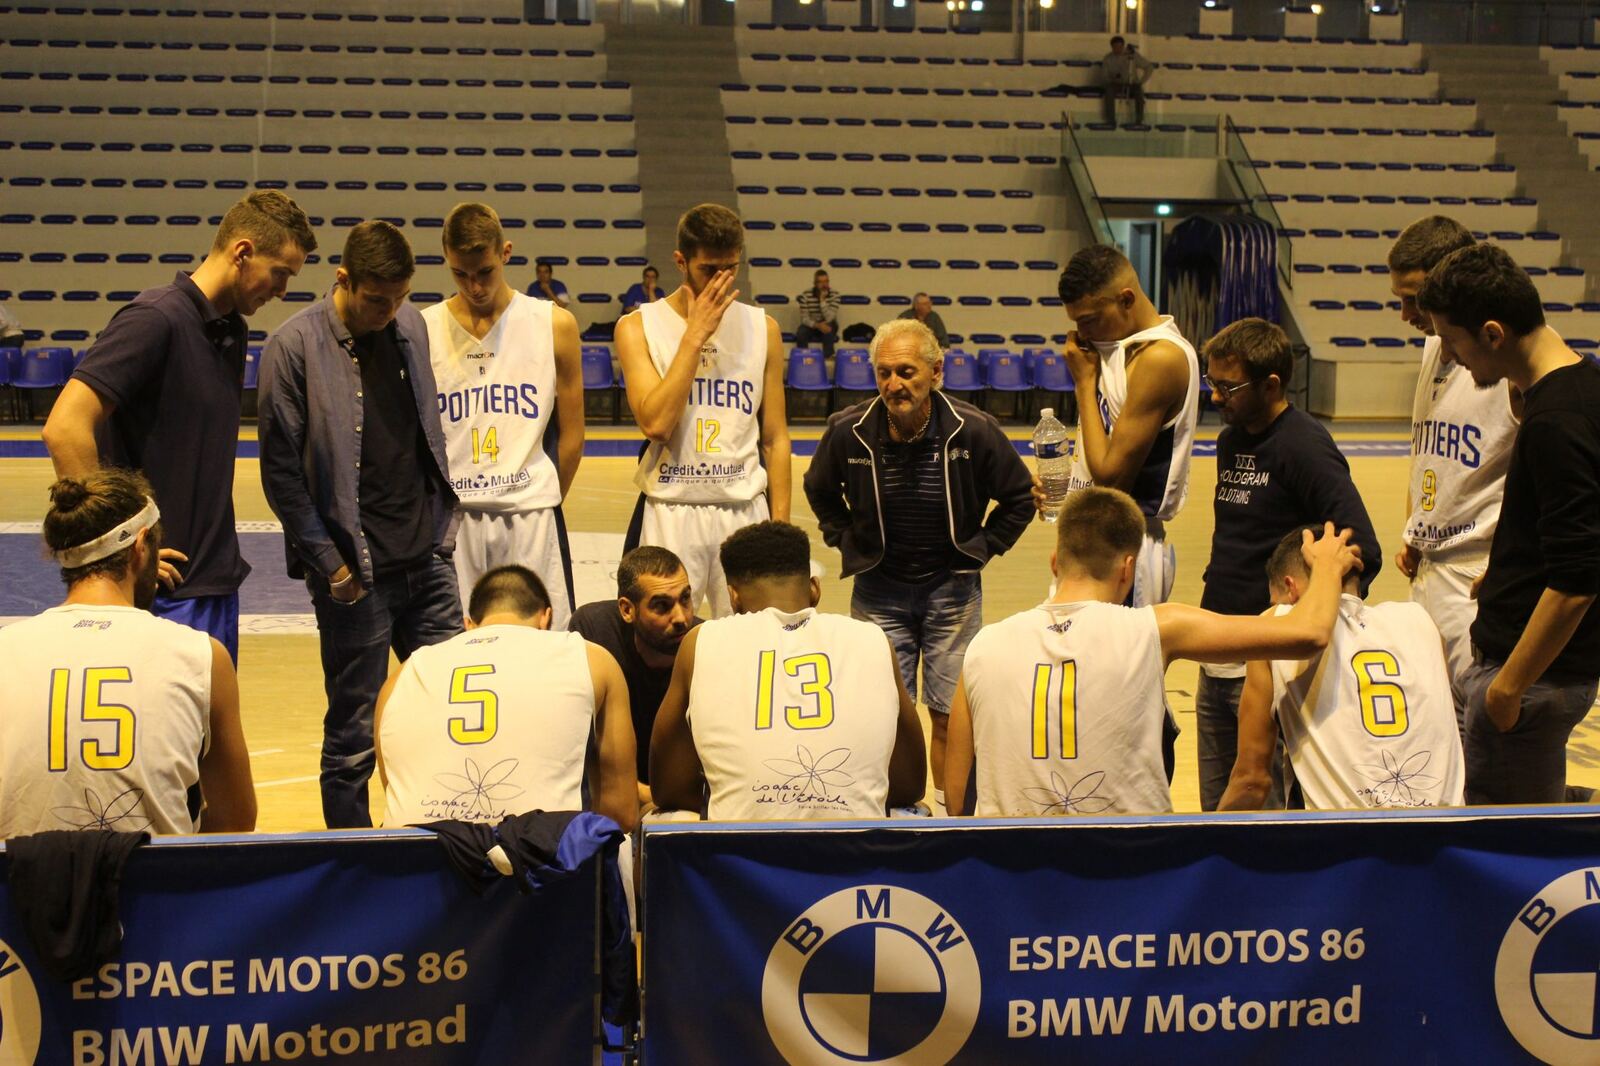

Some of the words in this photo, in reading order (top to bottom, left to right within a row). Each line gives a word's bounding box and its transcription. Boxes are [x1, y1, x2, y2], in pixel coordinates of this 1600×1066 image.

[467, 351, 495, 360] macron
[688, 378, 754, 415] ITIERS
[471, 426, 500, 465] 14
[696, 417, 721, 454] 12
[449, 477, 473, 490] édit
[490, 468, 531, 488] Mutuel
[659, 463, 695, 476] Crédit
[712, 462, 745, 476] Mutuel
[1217, 487, 1251, 505] CLOTHING
[1421, 470, 1437, 512] 9
[1427, 520, 1476, 540] Mutuel
[447, 664, 499, 745] 5
[755, 649, 835, 731] 13
[1031, 659, 1078, 760] 11
[1350, 649, 1410, 737] 6
[47, 666, 137, 773] 15
[420, 795, 469, 808] isaac
[752, 779, 801, 792] isaac
[756, 794, 776, 804] de
[424, 809, 445, 819] de
[450, 809, 506, 821] l'étoil
[1518, 870, 1600, 935] BM
[1009, 934, 1156, 971] ESPACE
[1167, 928, 1310, 967] MOTOS
[1319, 927, 1366, 961] 86
[73, 960, 235, 1000] ESPACE
[248, 953, 404, 993] MOTOS
[417, 948, 469, 984] 86
[1007, 997, 1132, 1038] BMW
[1144, 984, 1362, 1034] Motorrad
[72, 1024, 209, 1066] BMW
[225, 1004, 467, 1065] Motorrad
